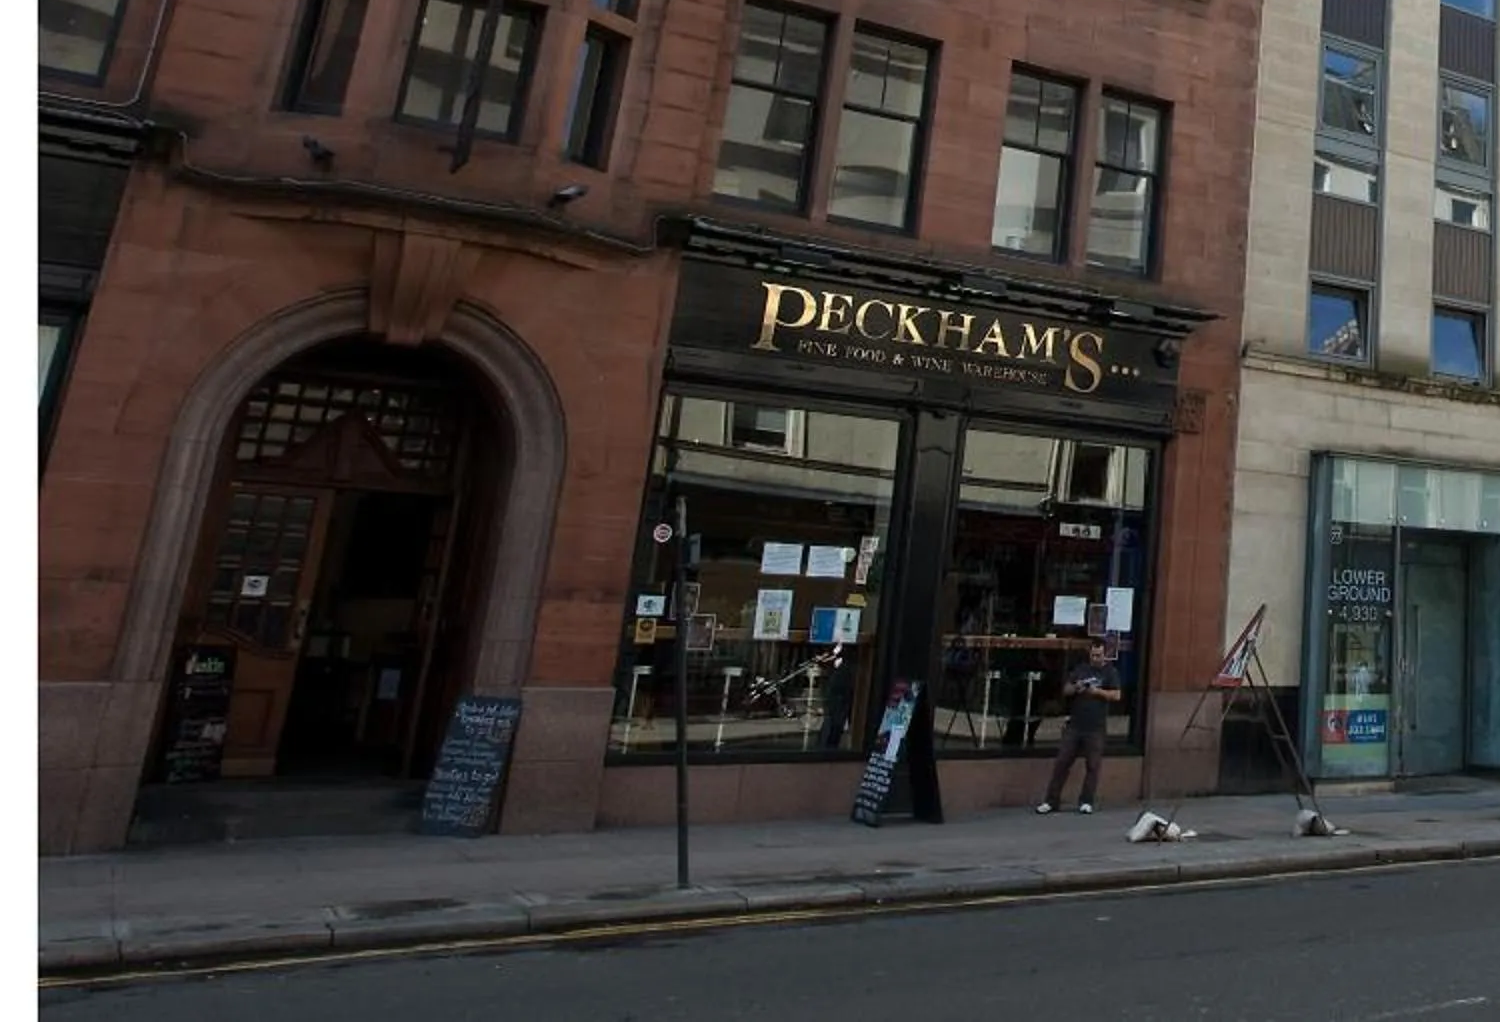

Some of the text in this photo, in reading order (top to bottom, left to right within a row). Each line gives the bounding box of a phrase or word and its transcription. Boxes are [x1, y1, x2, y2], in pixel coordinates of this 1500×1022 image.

[799, 339, 1050, 387] FINE FOOD & WINE WAREHOUSE
[1333, 569, 1385, 585] LOWER
[1328, 585, 1391, 603] GROUND
